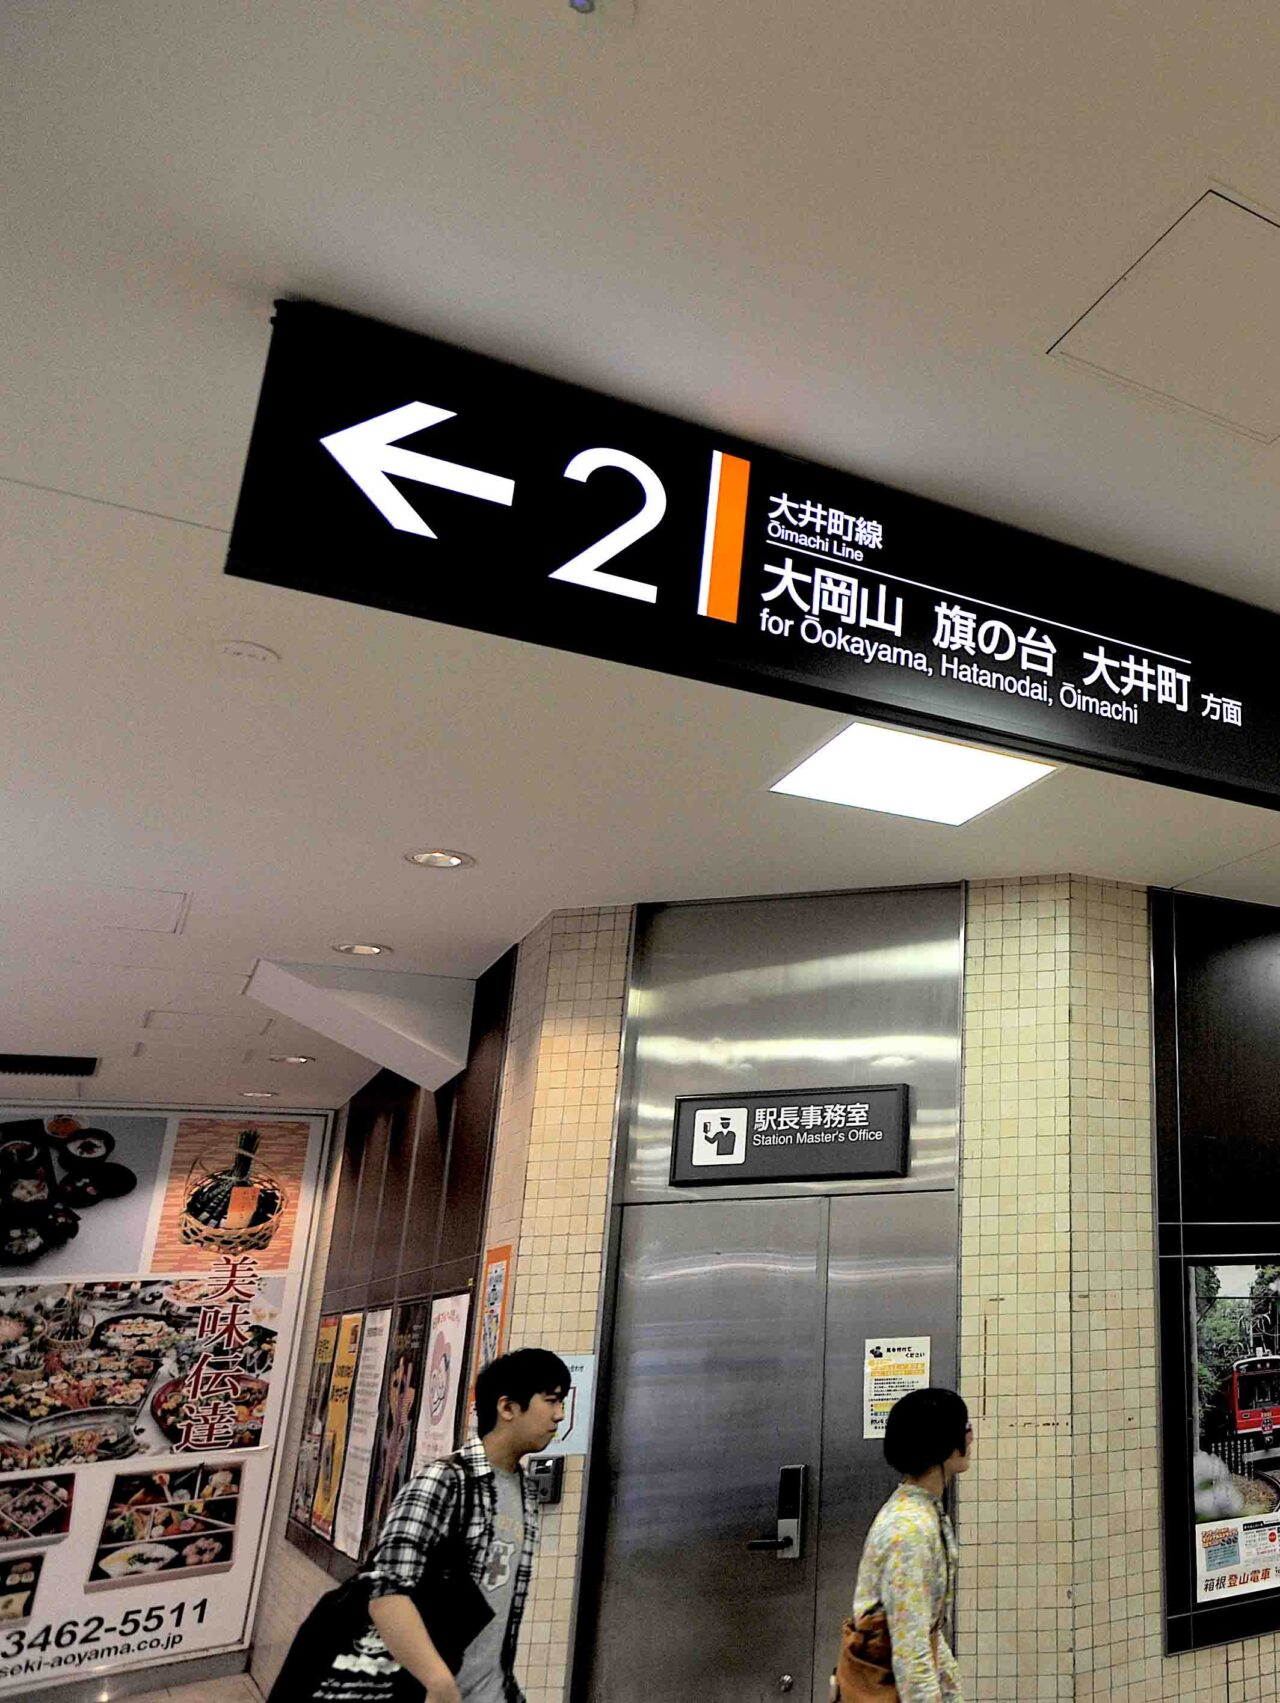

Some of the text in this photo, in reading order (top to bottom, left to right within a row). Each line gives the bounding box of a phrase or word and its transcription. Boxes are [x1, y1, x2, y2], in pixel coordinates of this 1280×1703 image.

[548, 447, 667, 604] 2
[769, 493, 883, 550] 大井町線
[833, 538, 864, 562] Line
[760, 608, 791, 640] for
[941, 656, 1053, 706] Hatanodai,
[761, 558, 1242, 727] 大岡山 旗の台 大井町 方面
[753, 1129, 883, 1146] Station Master's Office
[754, 1103, 870, 1132] 駅長事務室
[174, 1256, 261, 1452] 美味伝達
[1204, 1567, 1272, 1592] 箱根登山電車
